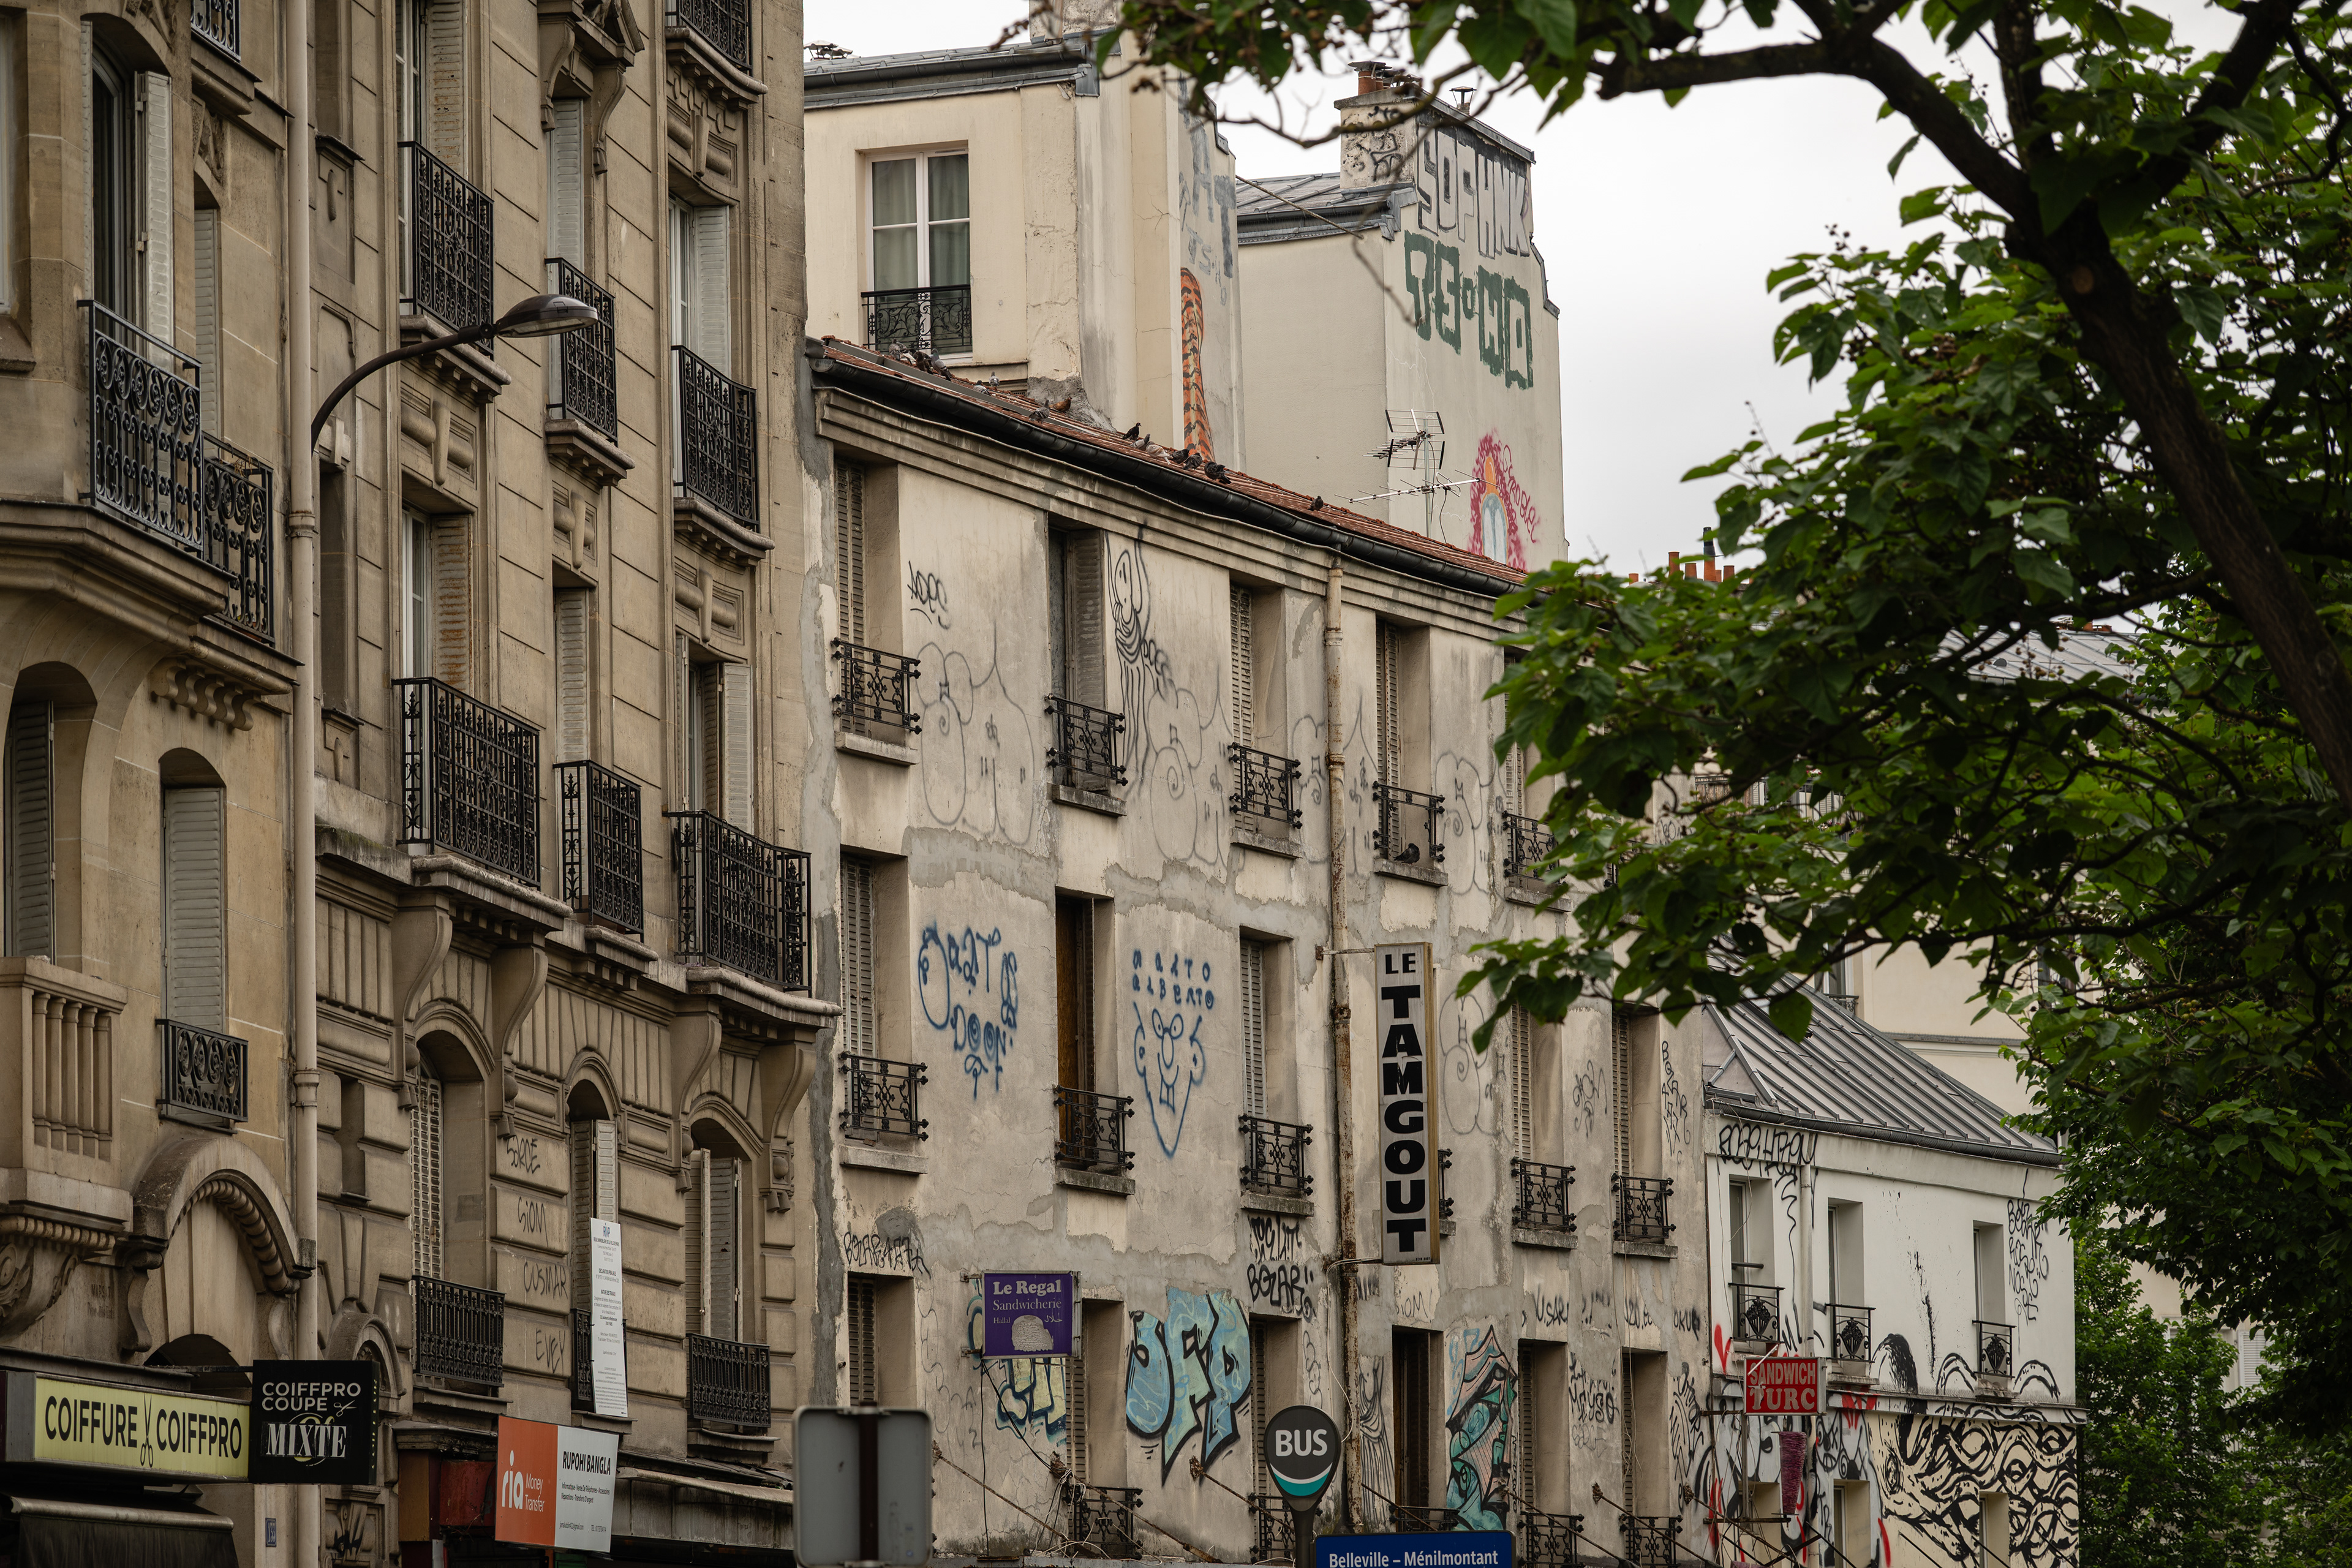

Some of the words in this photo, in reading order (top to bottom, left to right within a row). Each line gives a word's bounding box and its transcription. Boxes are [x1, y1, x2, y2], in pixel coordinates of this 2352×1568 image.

[1385, 953, 1416, 974] LE
[1381, 984, 1426, 1253] TAMGOUT
[993, 1281, 1012, 1295] Le
[1016, 1280, 1061, 1297] Regal
[993, 1297, 1062, 1311] Sandwicherie
[1750, 1362, 1815, 1385] SANDWICH
[262, 1382, 361, 1397] COIFFPRO
[1749, 1387, 1815, 1411] TURC
[262, 1397, 328, 1411] COUPE
[45, 1395, 138, 1449] COIFFURE
[156, 1409, 242, 1459] COIFFPRO
[266, 1423, 347, 1458] MIXTE
[1275, 1429, 1328, 1457] BUS
[562, 1450, 586, 1472] RUPOHI
[586, 1454, 611, 1476] BANGLA
[502, 1450, 524, 1510] ria
[526, 1472, 543, 1495] Money
[525, 1494, 545, 1513] Transfer
[1330, 1552, 1389, 1568] Belleville
[1404, 1550, 1498, 1567] Ménilmontant
